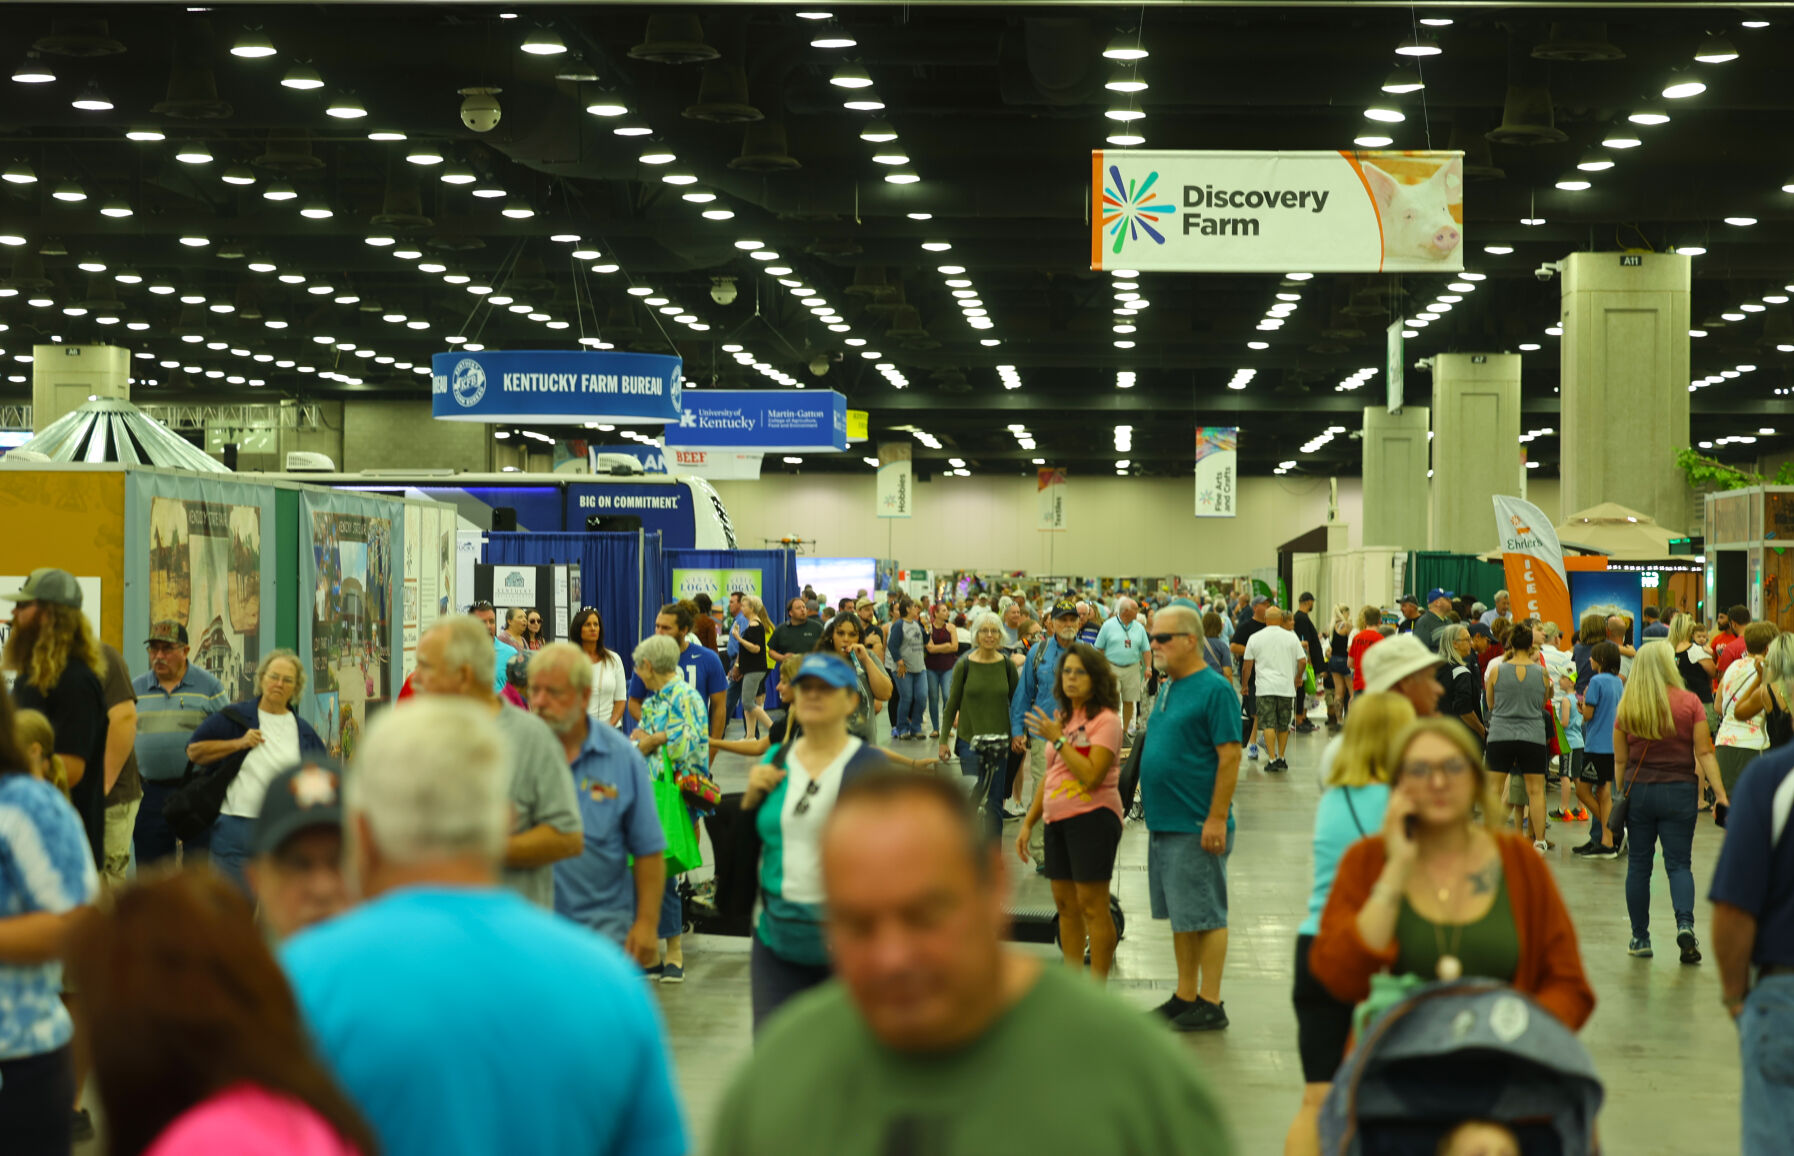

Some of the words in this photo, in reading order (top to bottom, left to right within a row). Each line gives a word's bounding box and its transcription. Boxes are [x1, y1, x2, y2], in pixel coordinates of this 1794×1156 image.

[1183, 185, 1329, 213] Discovery
[1183, 213, 1260, 236] Farm
[1624, 256, 1639, 266] A11
[503, 373, 578, 392] KENTUCKY
[581, 374, 618, 394] FARM
[621, 375, 663, 396] BUREAU
[699, 409, 734, 417] University
[735, 409, 742, 417] of
[768, 409, 824, 418] Martin-Gatton
[700, 417, 756, 431] Kentucky
[676, 451, 707, 464] BEEF
[1215, 472, 1223, 490] Arts
[579, 496, 596, 508] BIG
[598, 496, 612, 508] ON
[1214, 493, 1222, 512] Fine
[680, 584, 719, 592] LOGAN
[726, 583, 756, 592] LOGAN
